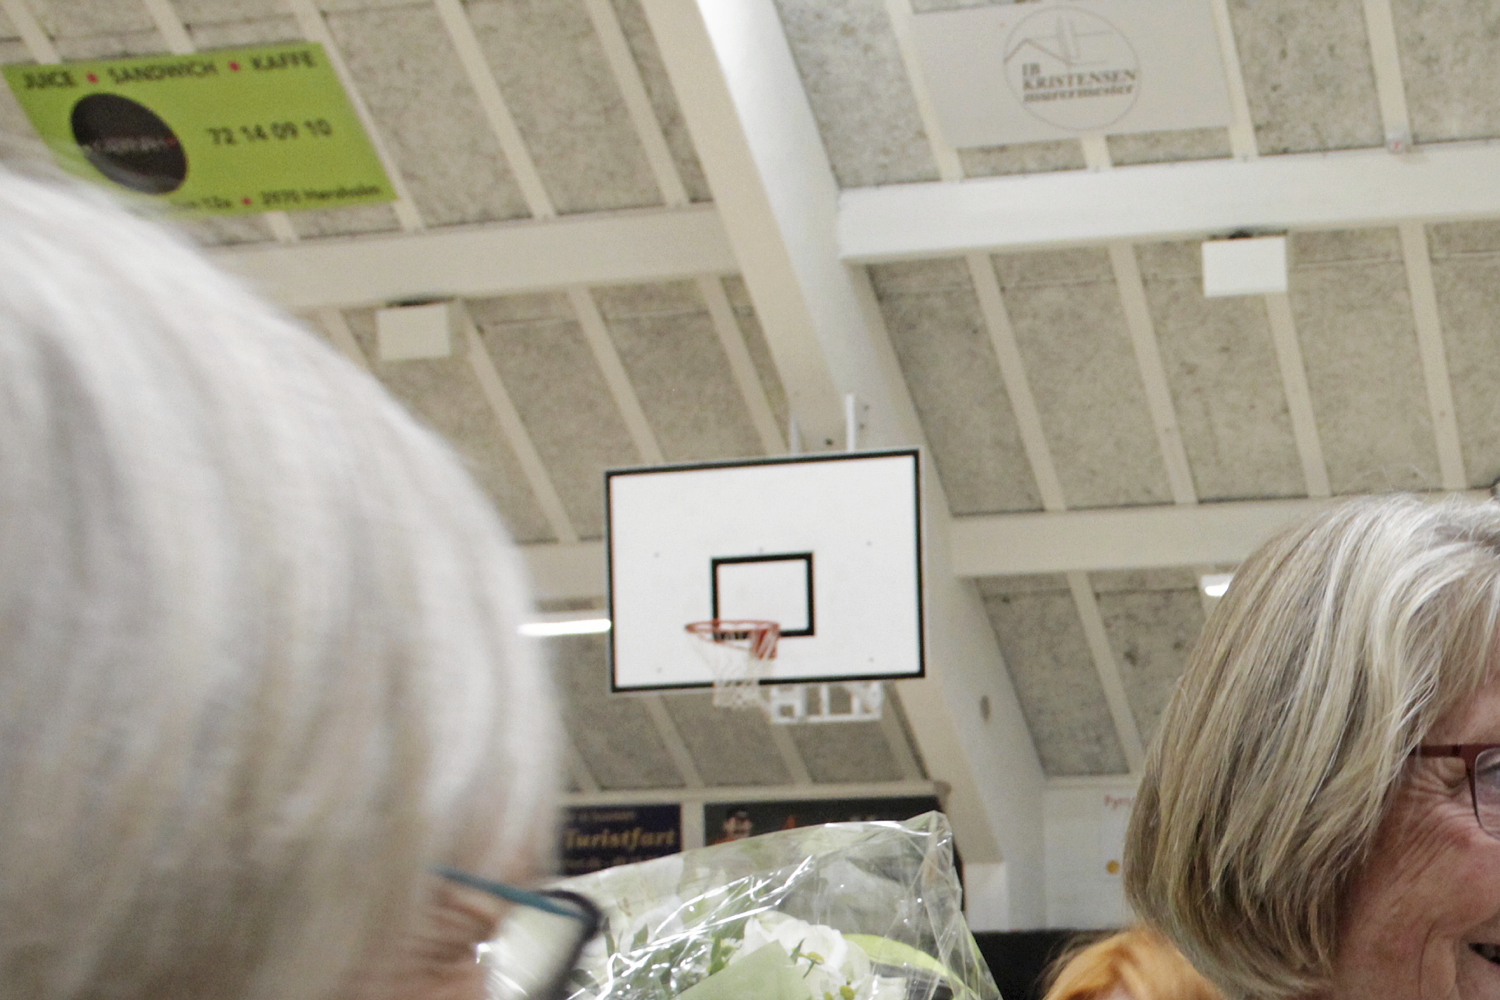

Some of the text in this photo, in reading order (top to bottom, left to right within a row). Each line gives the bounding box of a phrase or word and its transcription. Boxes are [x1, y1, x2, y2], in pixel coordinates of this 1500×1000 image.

[23, 50, 316, 89] JUICE SANDWICH KAFFE
[1022, 70, 1136, 90] KRISTENSEN
[206, 118, 332, 145] 72 14 09 10
[564, 826, 676, 851] Turistfart
